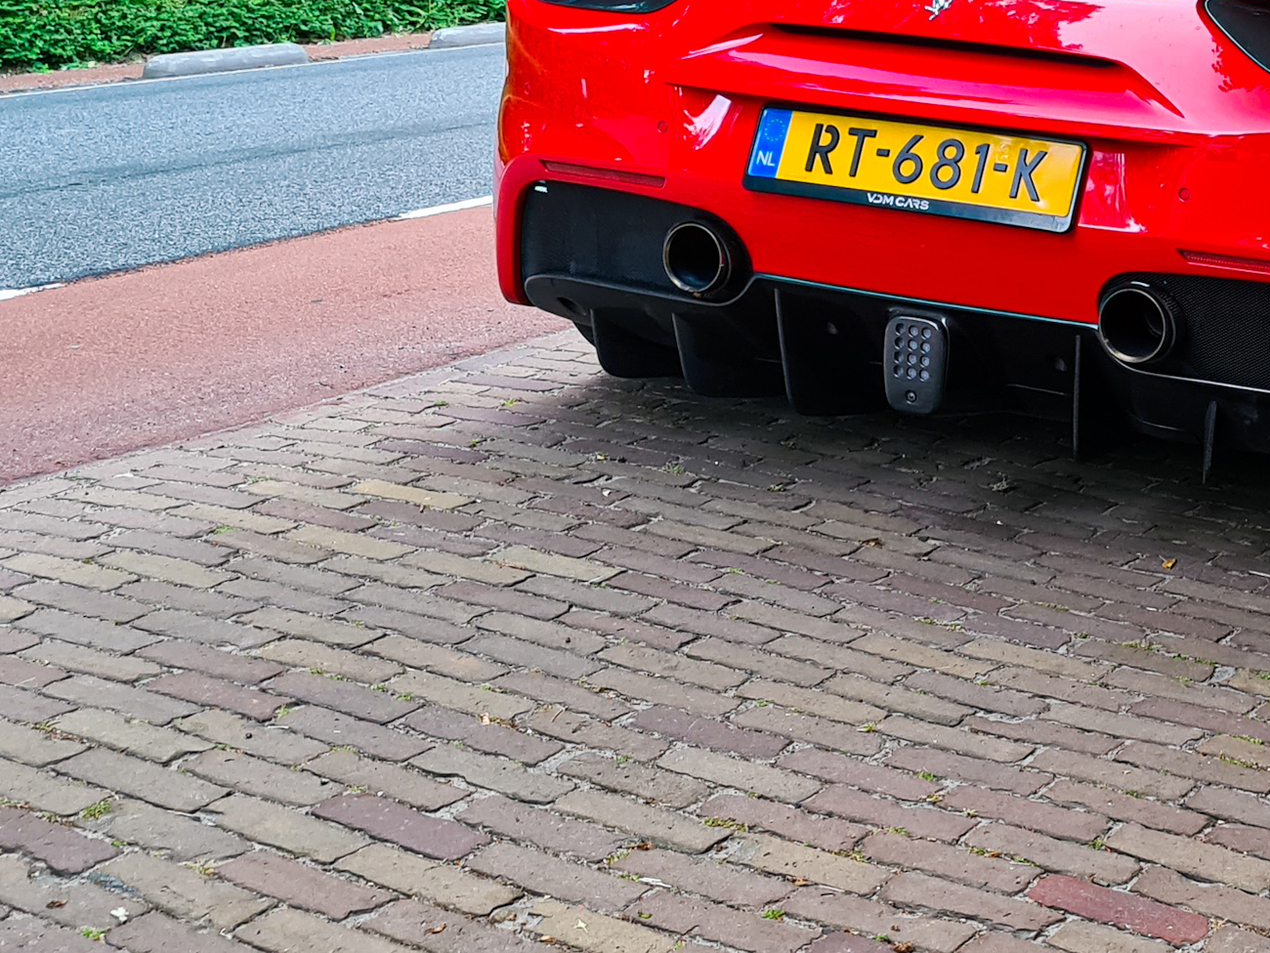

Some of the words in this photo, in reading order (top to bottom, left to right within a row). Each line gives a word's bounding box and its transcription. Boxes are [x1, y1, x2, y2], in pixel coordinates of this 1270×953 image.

[756, 150, 776, 167] NL
[805, 123, 1048, 202] RT-681-K
[867, 192, 895, 206] VDM
[895, 196, 930, 210] CARS
